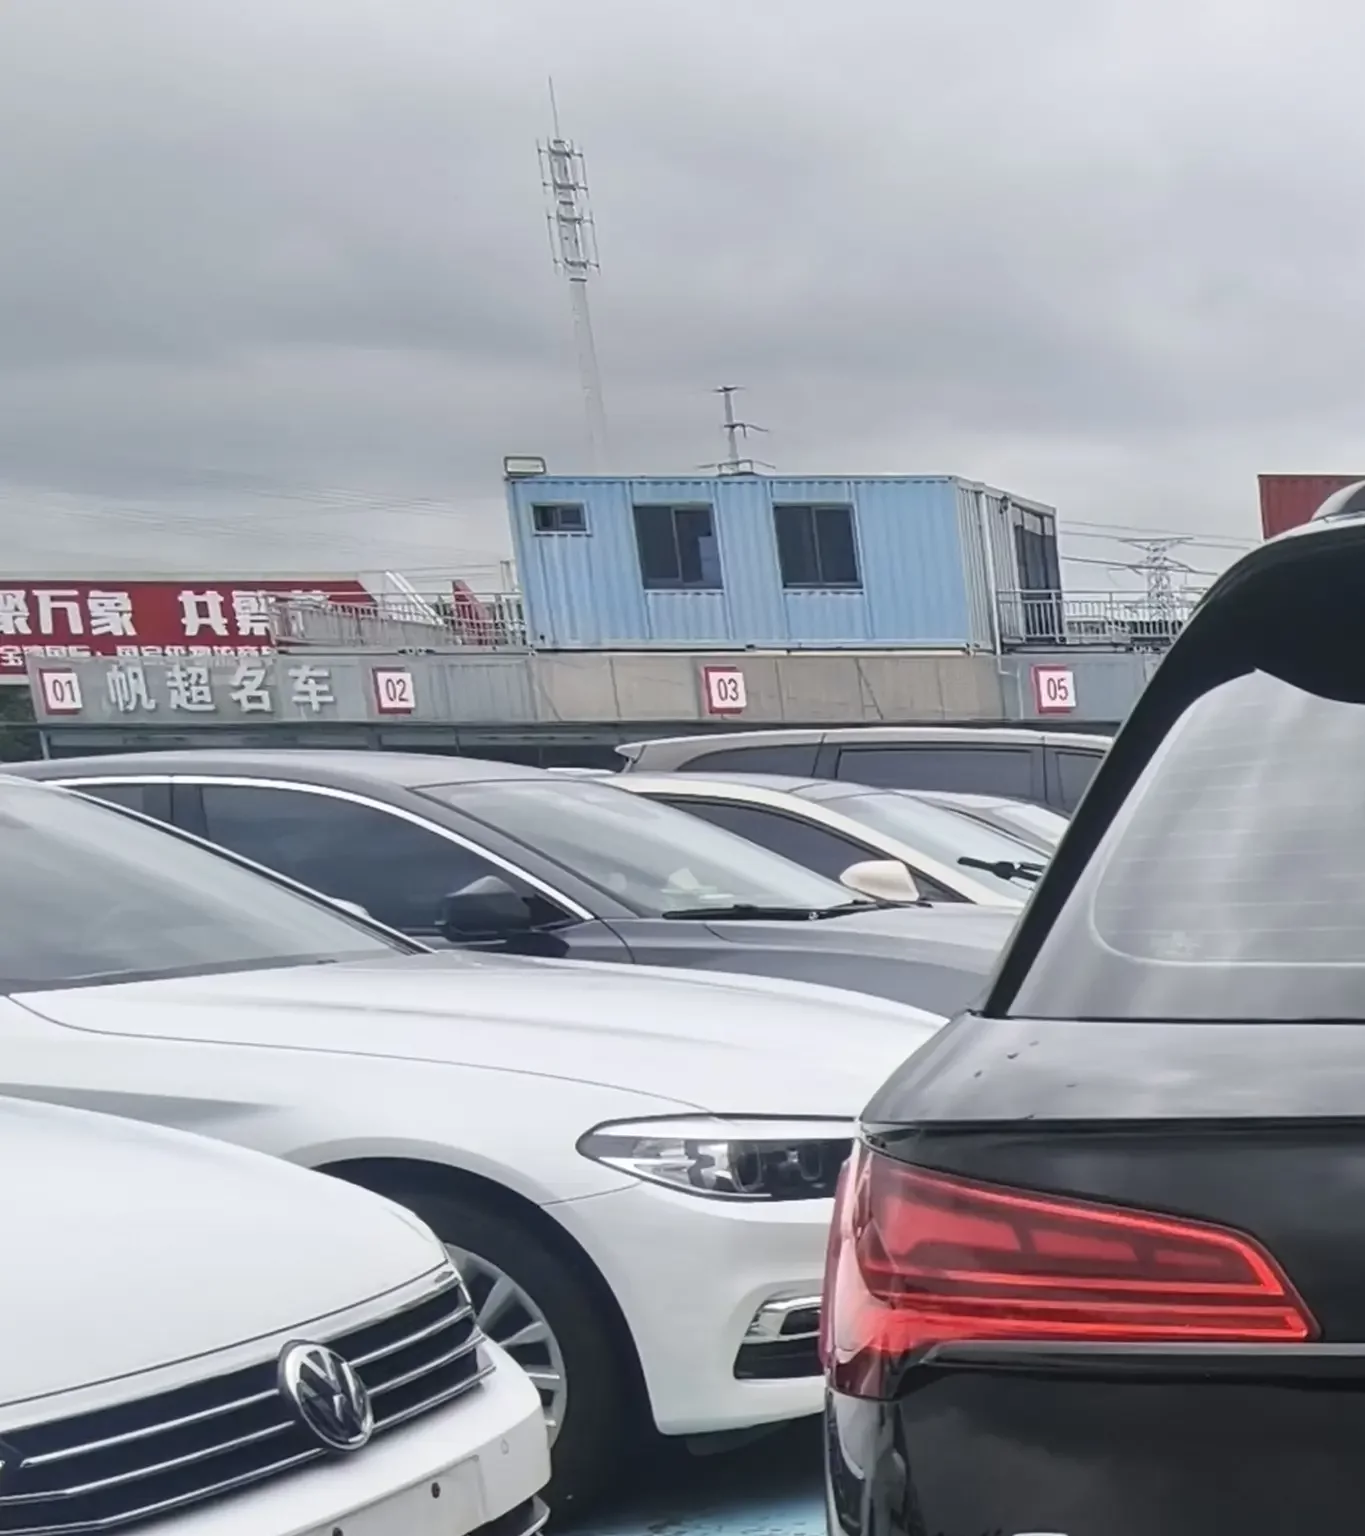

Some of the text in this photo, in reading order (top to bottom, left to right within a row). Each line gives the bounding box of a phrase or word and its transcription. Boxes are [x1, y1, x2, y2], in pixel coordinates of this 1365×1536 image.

[52, 679, 76, 703] 01
[106, 659, 335, 712] 帆超名车
[385, 678, 409, 702] 02
[717, 677, 740, 702] 03
[1046, 677, 1069, 701] 05
